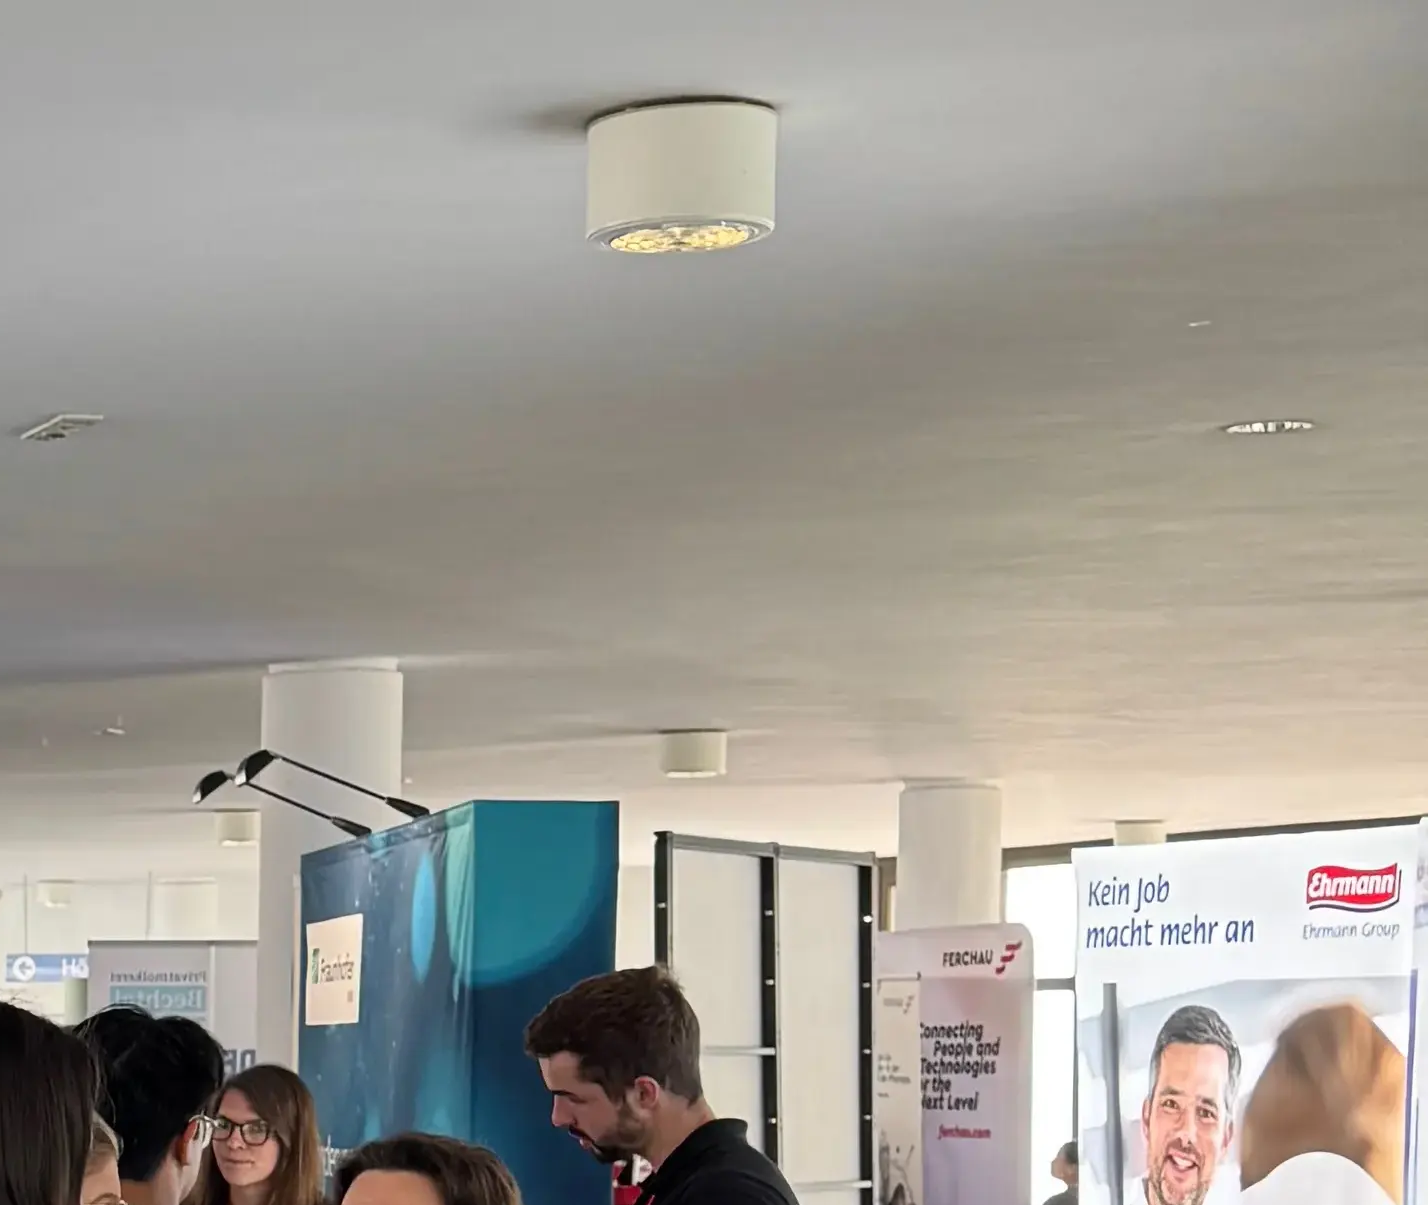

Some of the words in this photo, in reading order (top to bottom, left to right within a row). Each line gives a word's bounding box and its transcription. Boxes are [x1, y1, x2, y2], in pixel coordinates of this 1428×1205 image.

[1088, 876, 1129, 907] Kein
[1134, 874, 1170, 913] Job
[1308, 870, 1395, 899] Ehrmann
[1086, 918, 1154, 948] macht
[1160, 914, 1218, 945] mehr
[1225, 917, 1255, 943] an
[1302, 923, 1358, 940] Ehrmann
[1361, 922, 1400, 939] Group
[942, 950, 994, 967] FERCHAU
[933, 1040, 973, 1061] People
[977, 1036, 1000, 1057] and
[948, 1091, 979, 1111] Level
